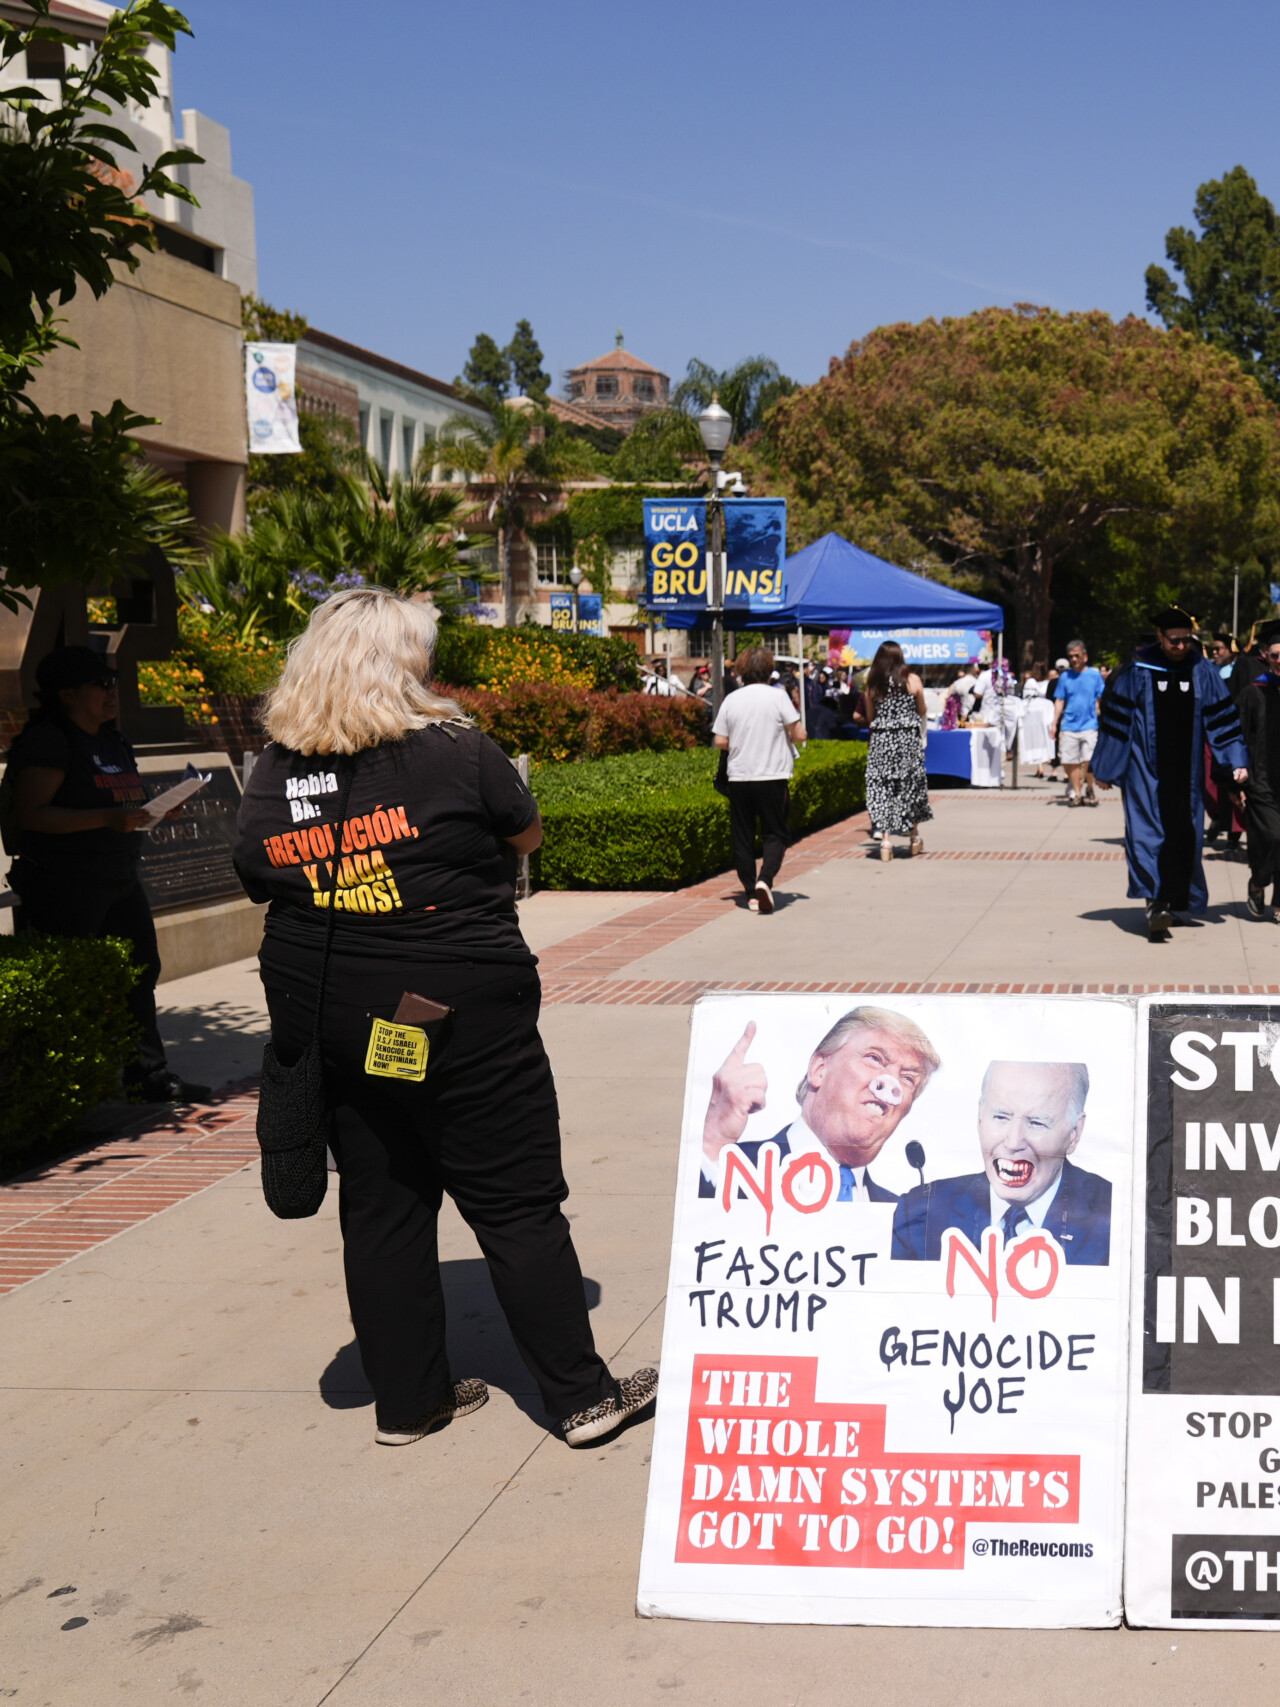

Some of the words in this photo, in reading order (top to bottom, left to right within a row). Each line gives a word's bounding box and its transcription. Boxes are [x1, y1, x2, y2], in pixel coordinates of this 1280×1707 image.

[651, 514, 698, 531] UCLA
[651, 542, 699, 568] GO
[552, 598, 570, 606] UCLA
[552, 609, 571, 620] GO
[901, 643, 950, 658] OWERS
[286, 771, 338, 800] Habla
[289, 797, 321, 823] BA:
[303, 864, 321, 892] Y
[379, 1026, 393, 1037] STOP
[395, 1031, 406, 1040] THE
[375, 1052, 417, 1066] PALESTINIANS
[376, 1044, 405, 1056] GENOCIDE
[407, 1049, 415, 1057] OF
[722, 1149, 833, 1236] NO
[693, 1240, 877, 1287] FASCIST
[946, 1233, 1060, 1322] NO
[689, 1289, 827, 1333] TRUMP
[1155, 1275, 1240, 1345] IN
[879, 1327, 1095, 1373] GENOCIDE
[701, 1370, 792, 1408] THE
[943, 1372, 1025, 1434] JOE
[698, 1418, 861, 1458] WHOLE
[1186, 1411, 1273, 1439] STOP
[691, 1465, 826, 1504] DAMN
[687, 1511, 783, 1551] GOT
[798, 1514, 860, 1553] TO
[876, 1516, 956, 1556] GO!
[971, 1538, 1094, 1559] @TheRevcoms
